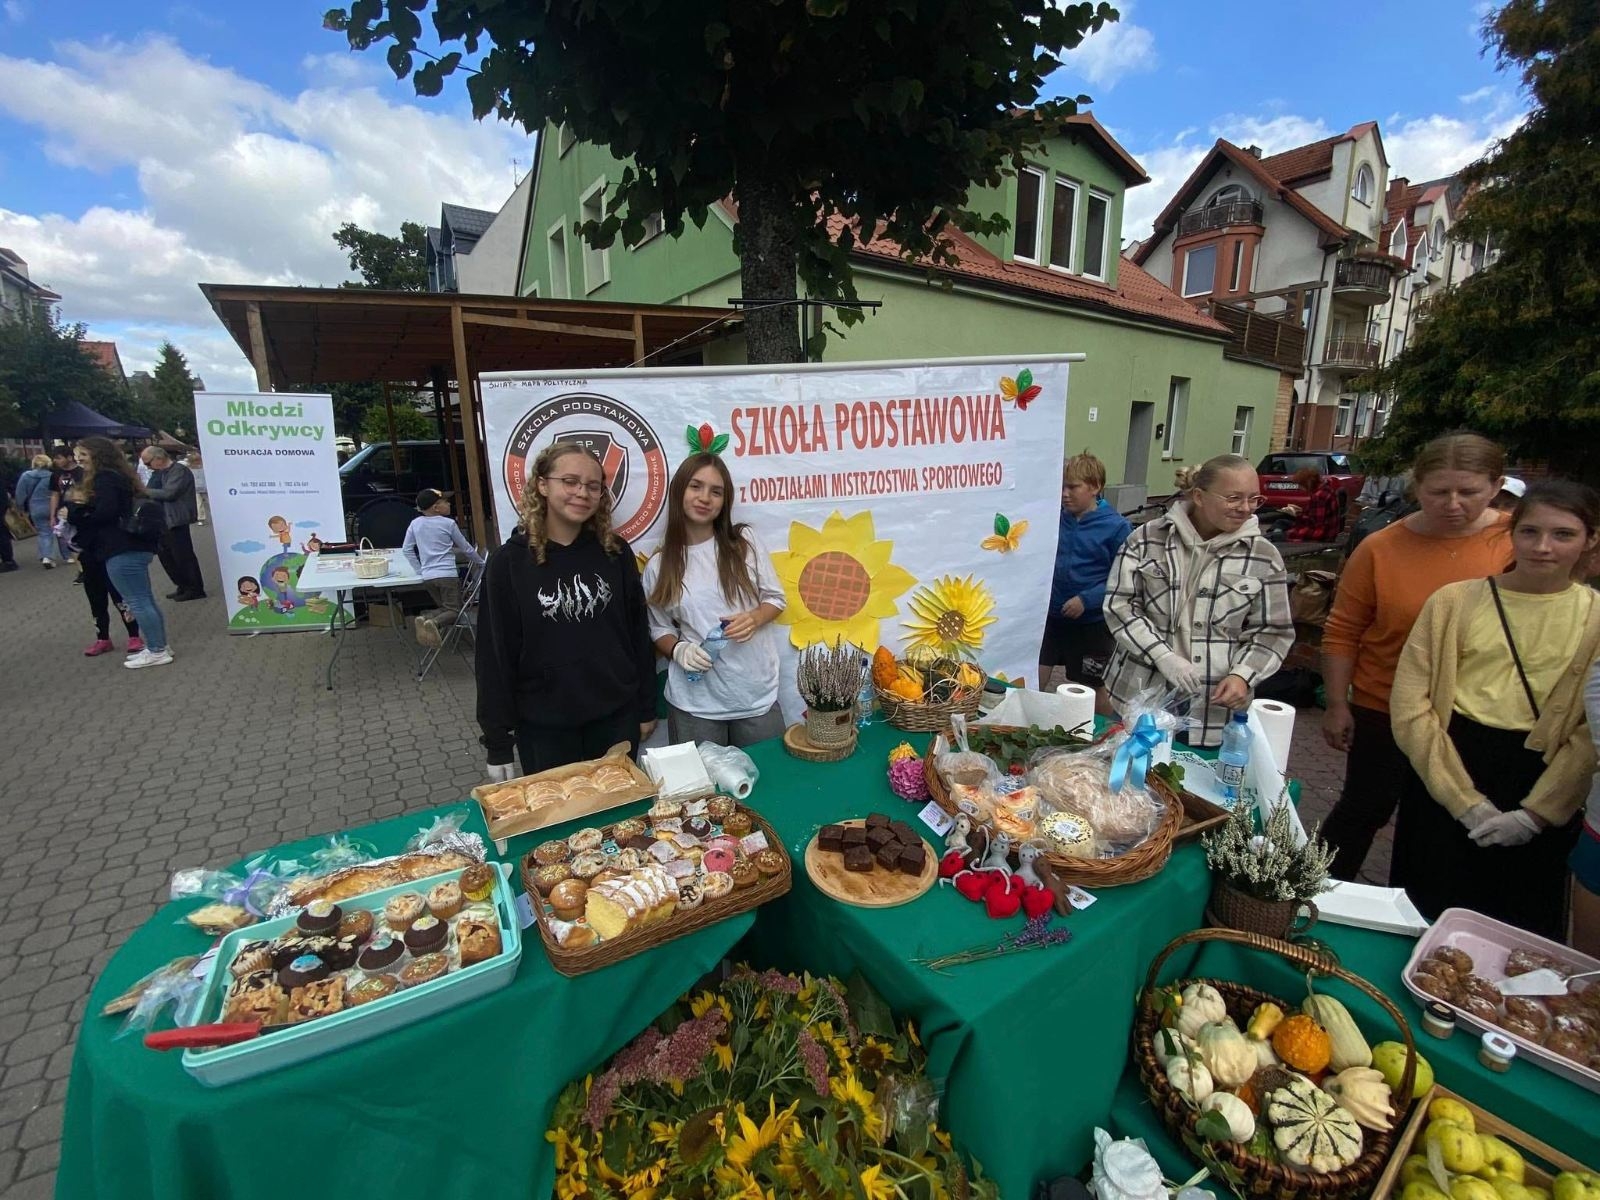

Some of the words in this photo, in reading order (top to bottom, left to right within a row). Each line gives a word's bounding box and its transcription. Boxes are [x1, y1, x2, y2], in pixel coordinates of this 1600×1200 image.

[207, 419, 324, 441] Odkrywcy
[227, 400, 304, 417] Młodzi
[518, 408, 558, 450] SZKOŁA
[562, 402, 650, 447] PODSTAWOWA
[731, 404, 828, 457] SZKOŁA
[835, 394, 1006, 450] PODSTAWOWA
[650, 455, 660, 501] KWIDZYNIE
[739, 486, 747, 503] z
[750, 474, 828, 502] ODDZIAŁAMI
[831, 468, 919, 497] MISTRZOSTWA
[922, 462, 1003, 491] SPORTOWEGO
